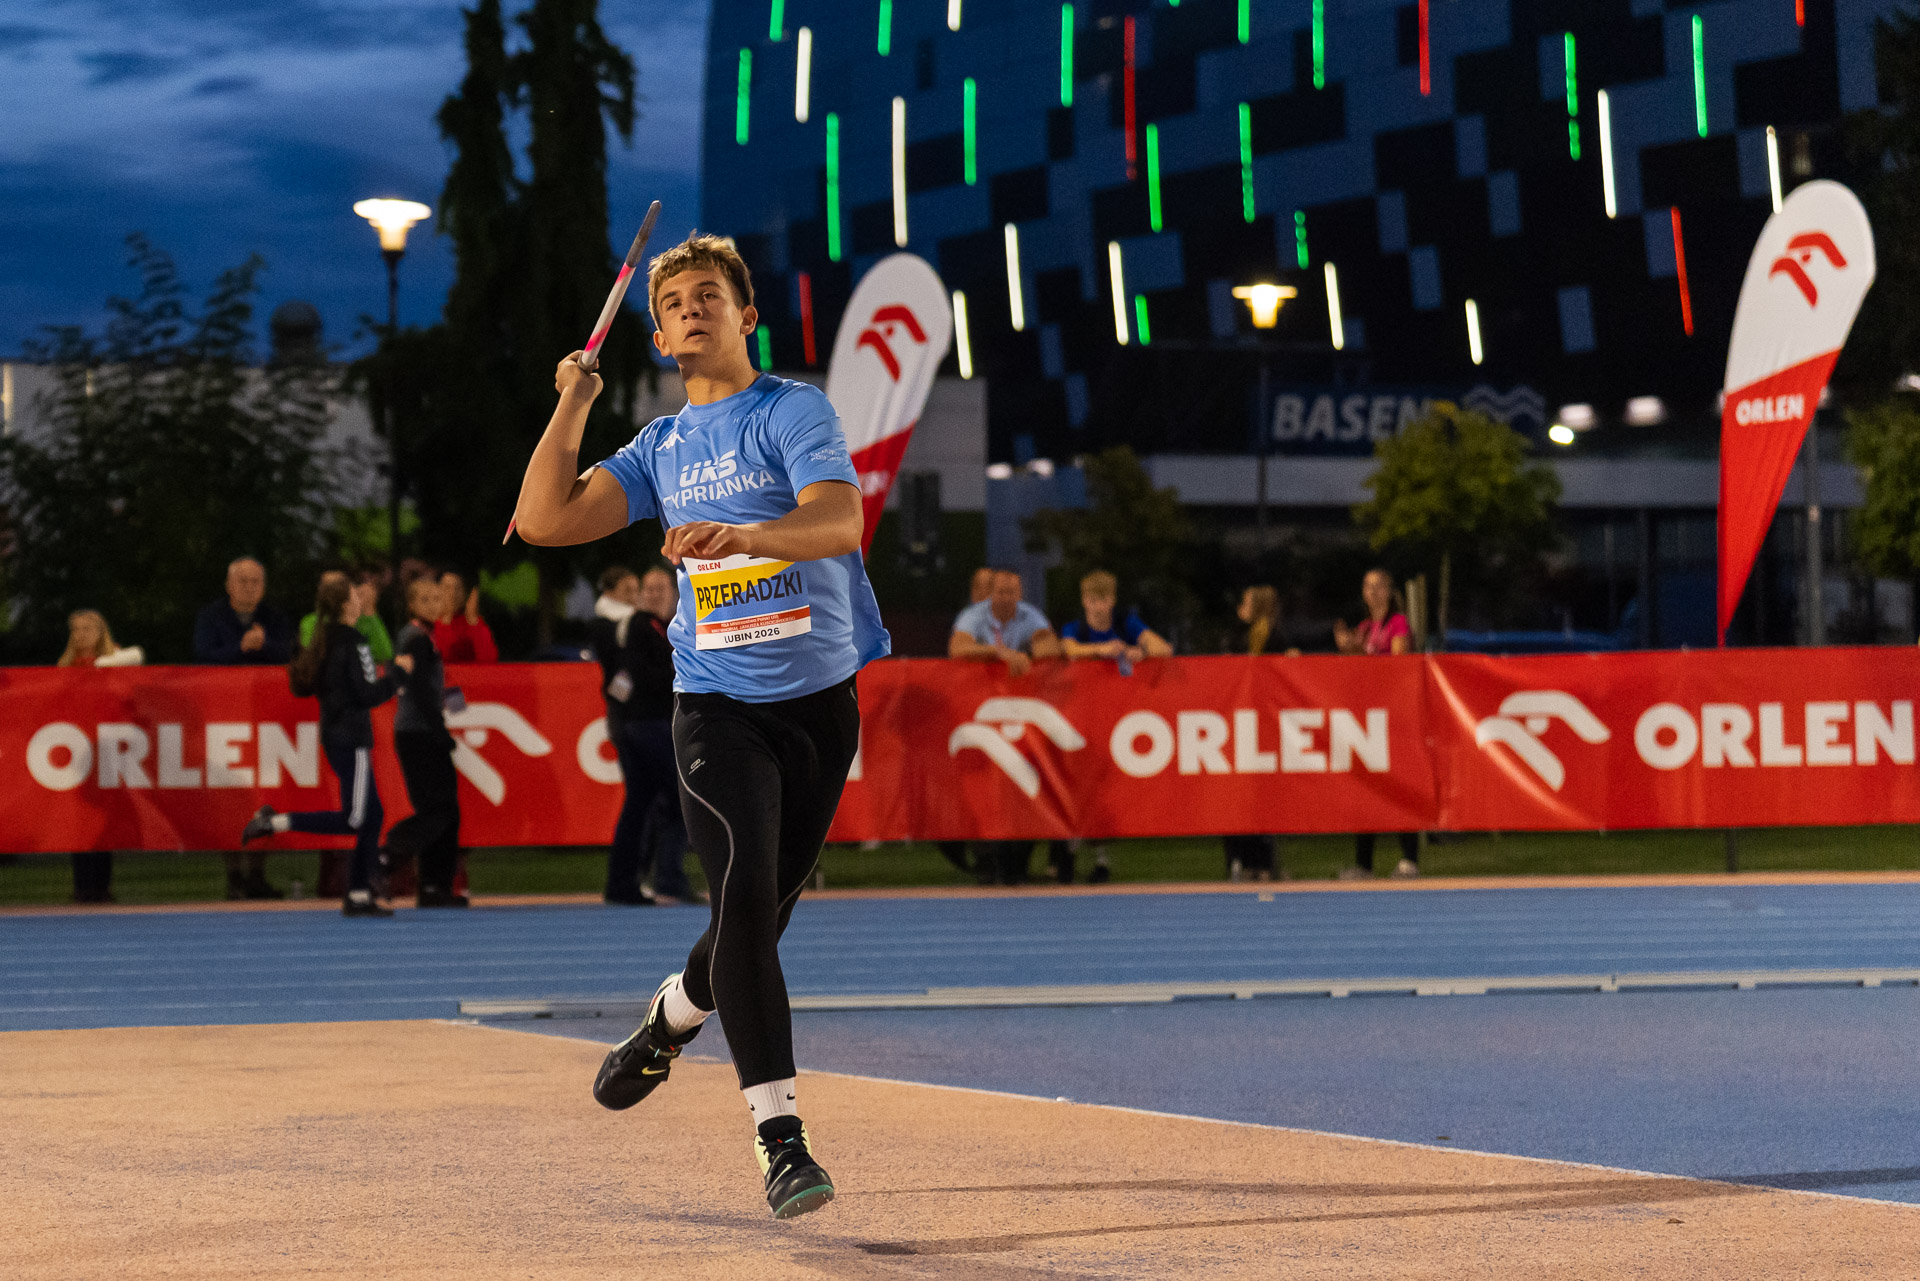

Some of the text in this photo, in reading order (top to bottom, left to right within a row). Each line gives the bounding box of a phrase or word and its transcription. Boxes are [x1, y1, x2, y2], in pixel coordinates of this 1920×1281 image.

[1735, 394, 1804, 426] ORLEN
[679, 450, 737, 487] UKS
[697, 562, 721, 571] ORLEN
[696, 570, 803, 610] PRZERADZKI
[724, 627, 781, 644] LUBIN 2026
[1109, 707, 1391, 778] ORLEN
[1634, 701, 1916, 771] ORLEN
[25, 721, 321, 791] ORLEN
